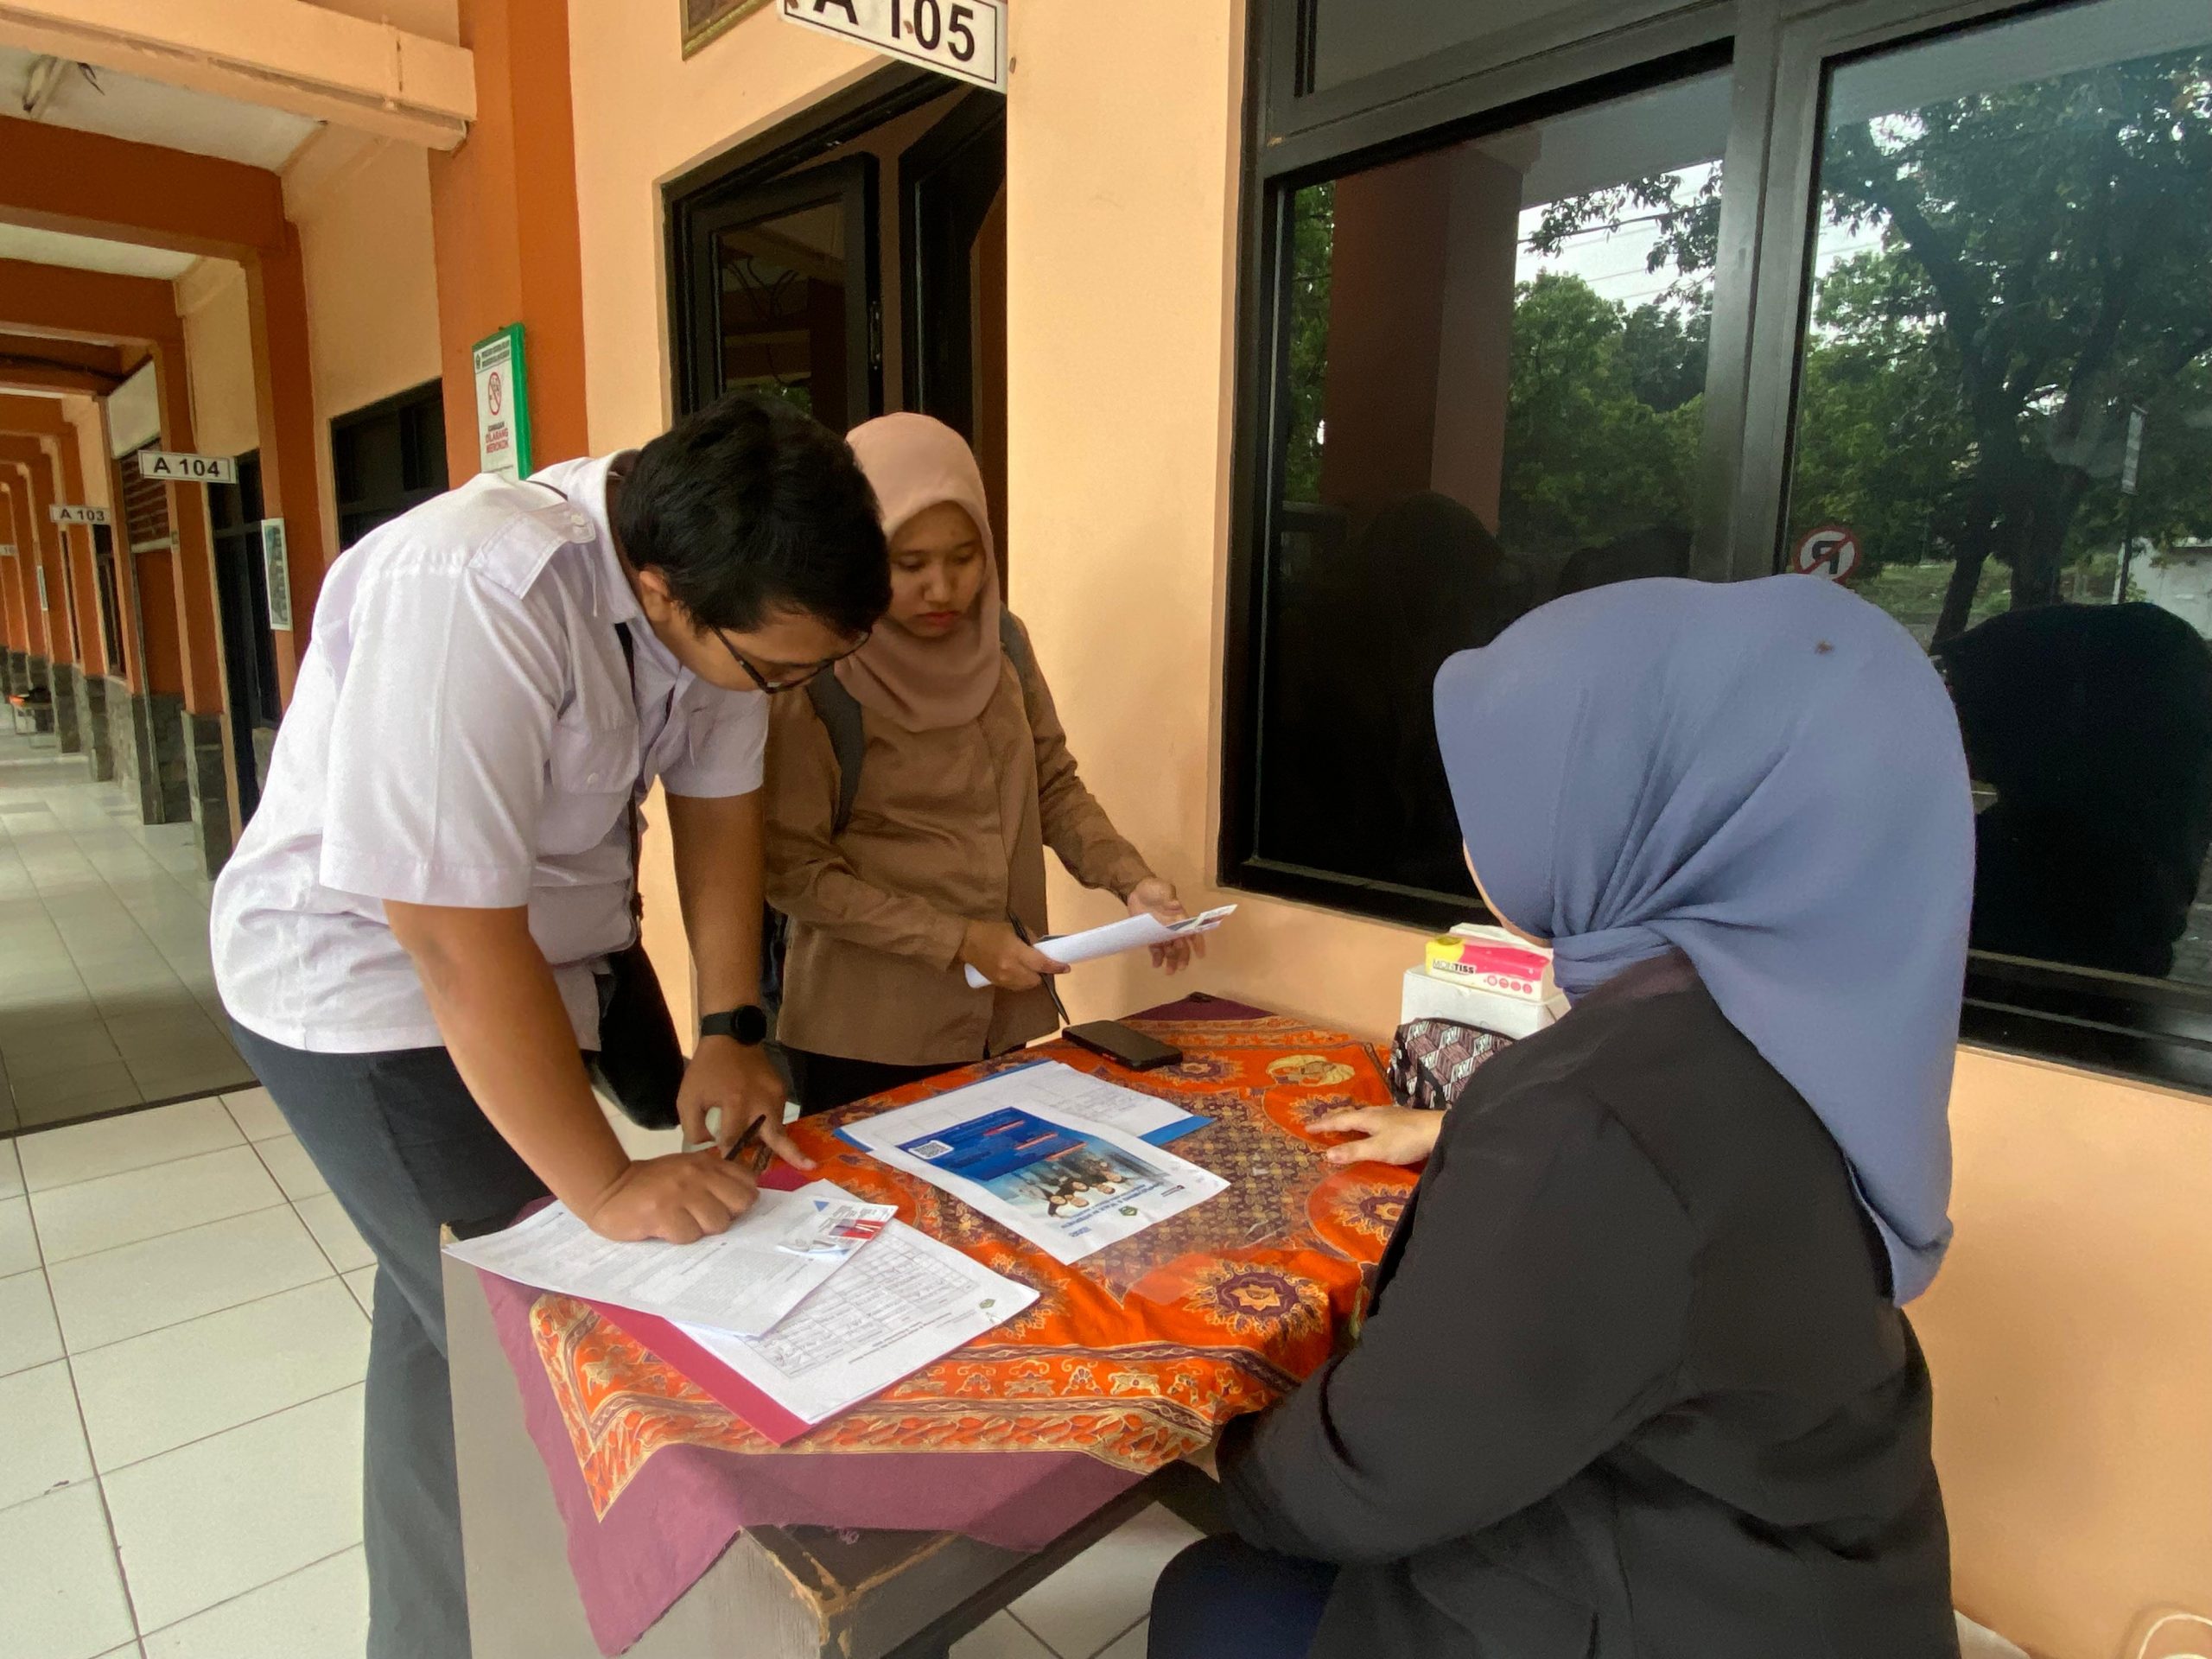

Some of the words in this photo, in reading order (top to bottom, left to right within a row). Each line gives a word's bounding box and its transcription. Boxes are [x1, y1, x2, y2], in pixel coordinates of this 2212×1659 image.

[890, 0, 976, 62] 105
[153, 457, 171, 474] A
[179, 458, 219, 477] 104
[60, 508, 72, 519] A
[77, 510, 105, 522] 103
